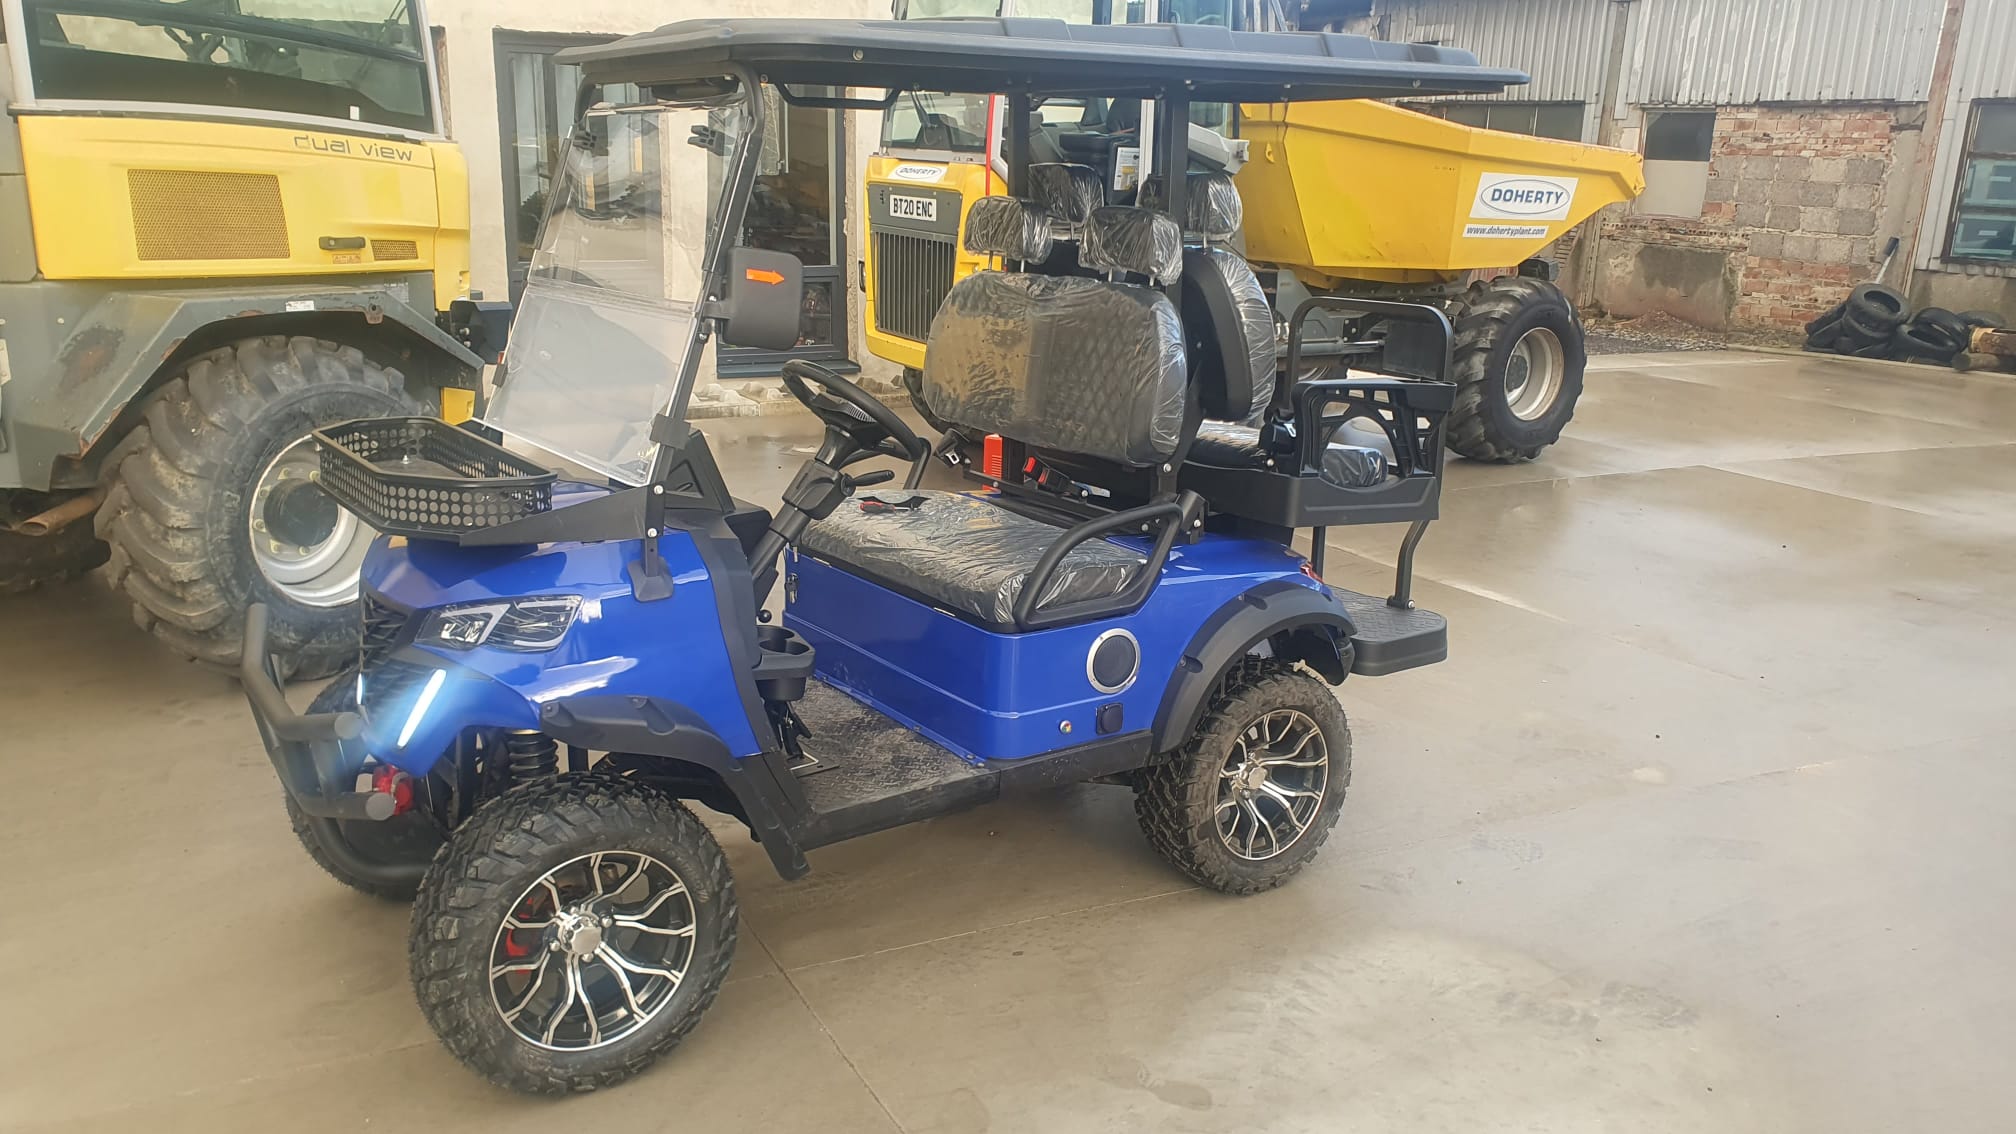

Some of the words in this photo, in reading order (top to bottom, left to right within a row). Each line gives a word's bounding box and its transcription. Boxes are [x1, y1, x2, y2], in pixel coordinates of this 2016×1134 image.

[361, 143, 412, 161] view
[1491, 188, 1564, 204] DOHERTY
[893, 198, 914, 216] BT20
[916, 200, 933, 218] ENC
[1466, 226, 1546, 236] www.dohertyplant.com
